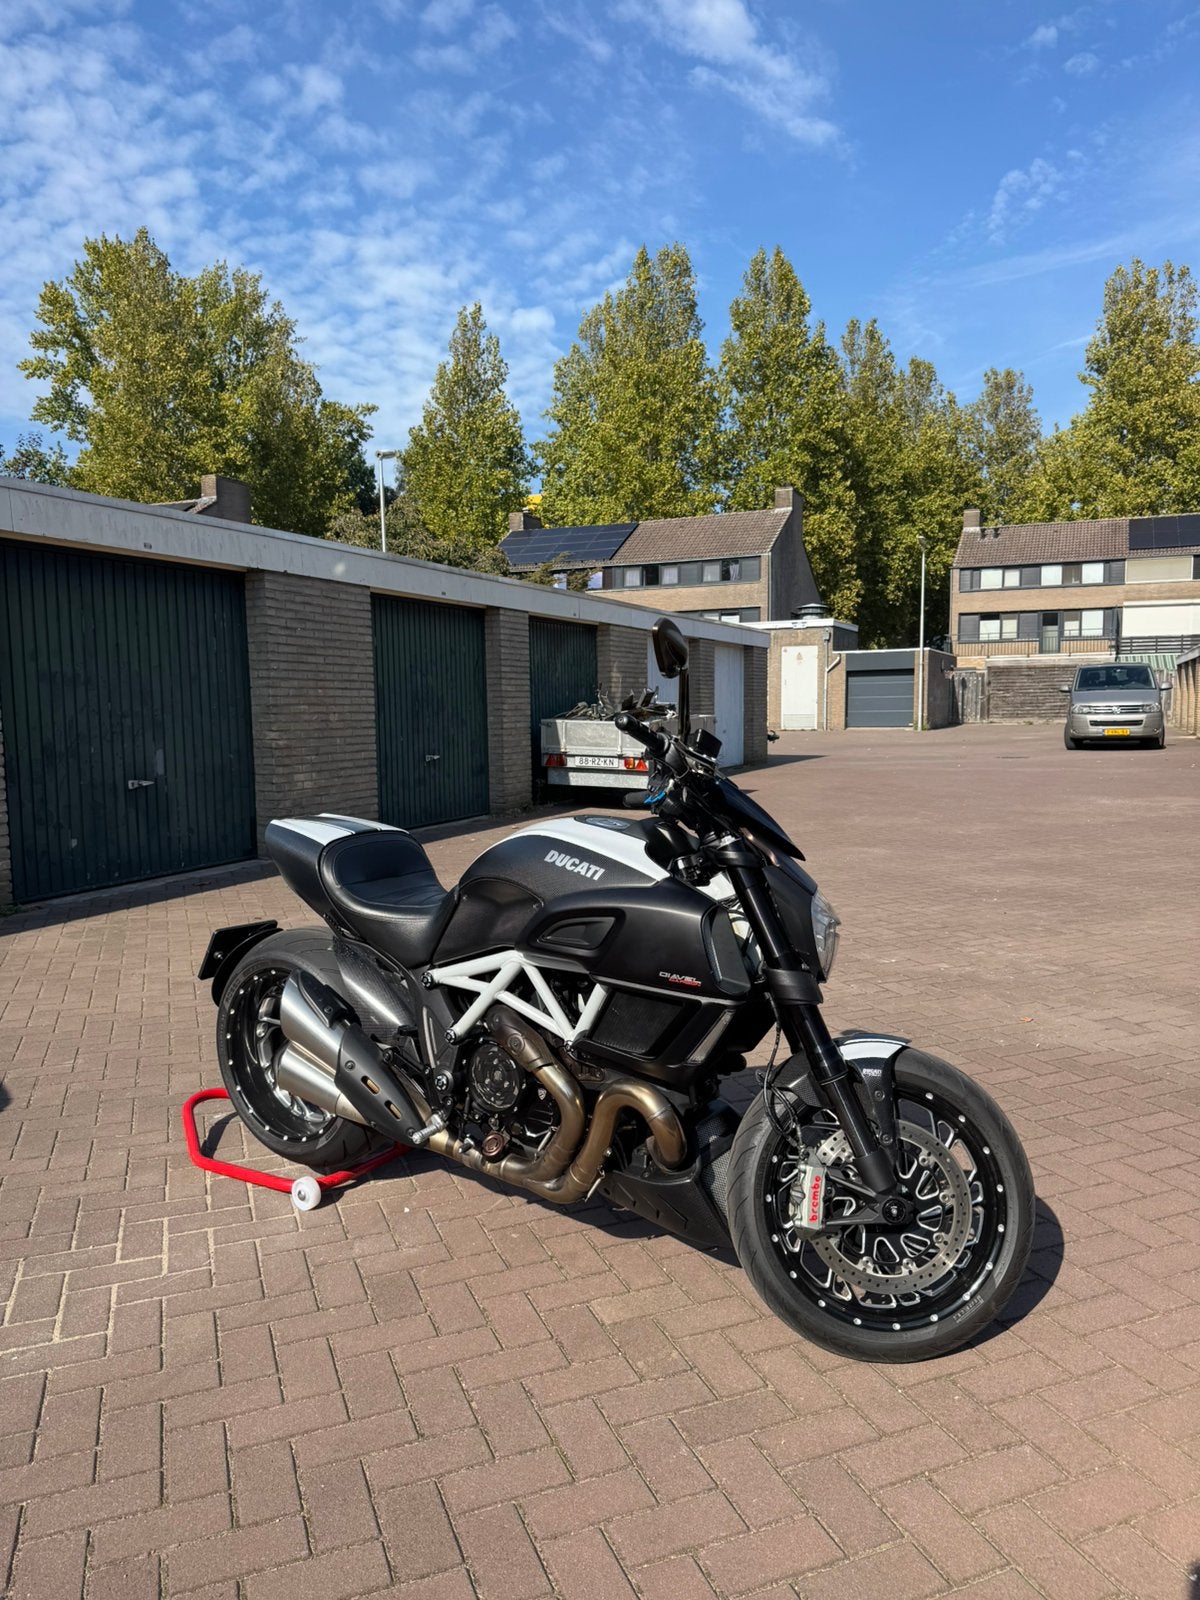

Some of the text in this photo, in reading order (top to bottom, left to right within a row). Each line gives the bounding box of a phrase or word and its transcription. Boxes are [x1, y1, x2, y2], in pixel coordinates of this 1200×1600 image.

[579, 757, 614, 766] 88-RZ-KN
[543, 849, 605, 881] DUCATI
[659, 971, 702, 984] DIAVEL
[809, 1175, 821, 1222] brembo
